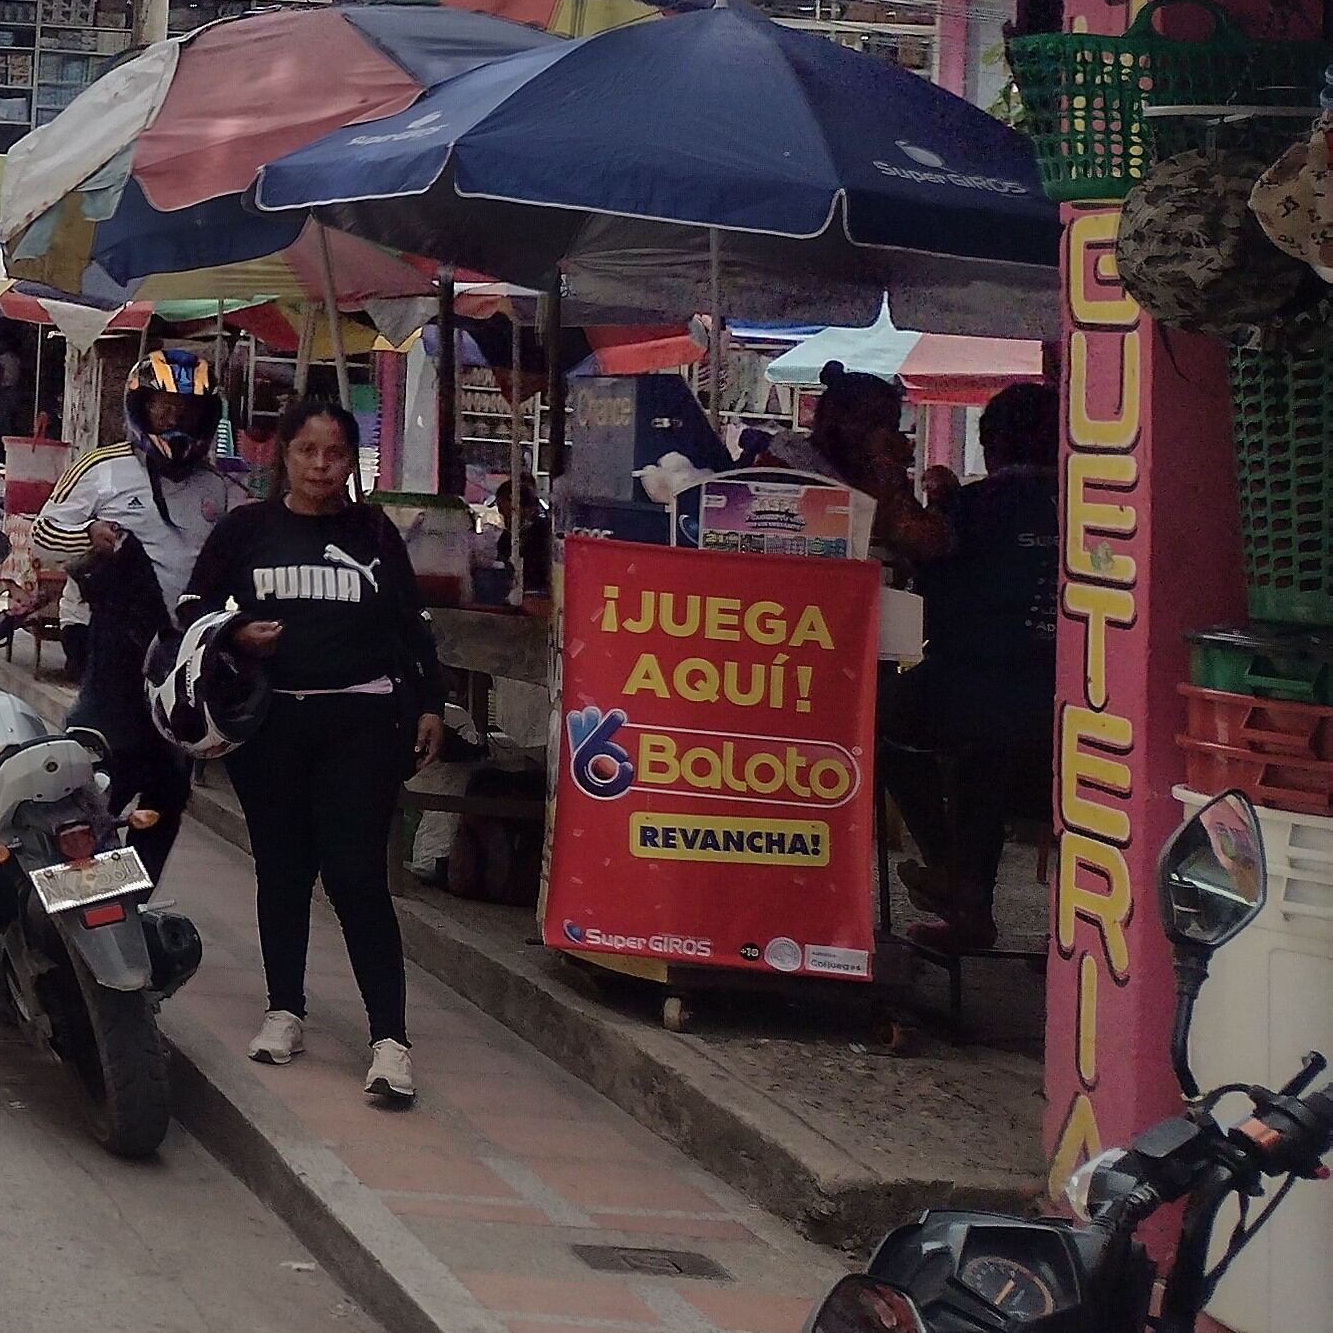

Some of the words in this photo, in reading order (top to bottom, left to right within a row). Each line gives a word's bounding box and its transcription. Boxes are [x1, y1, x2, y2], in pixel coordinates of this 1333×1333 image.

[253, 565, 361, 603] PUMA
[601, 585, 835, 650] ¡JUEGA
[621, 652, 813, 713] AQUÍ!
[637, 733, 850, 800] Baloto
[639, 824, 822, 858] REVANCHA!
